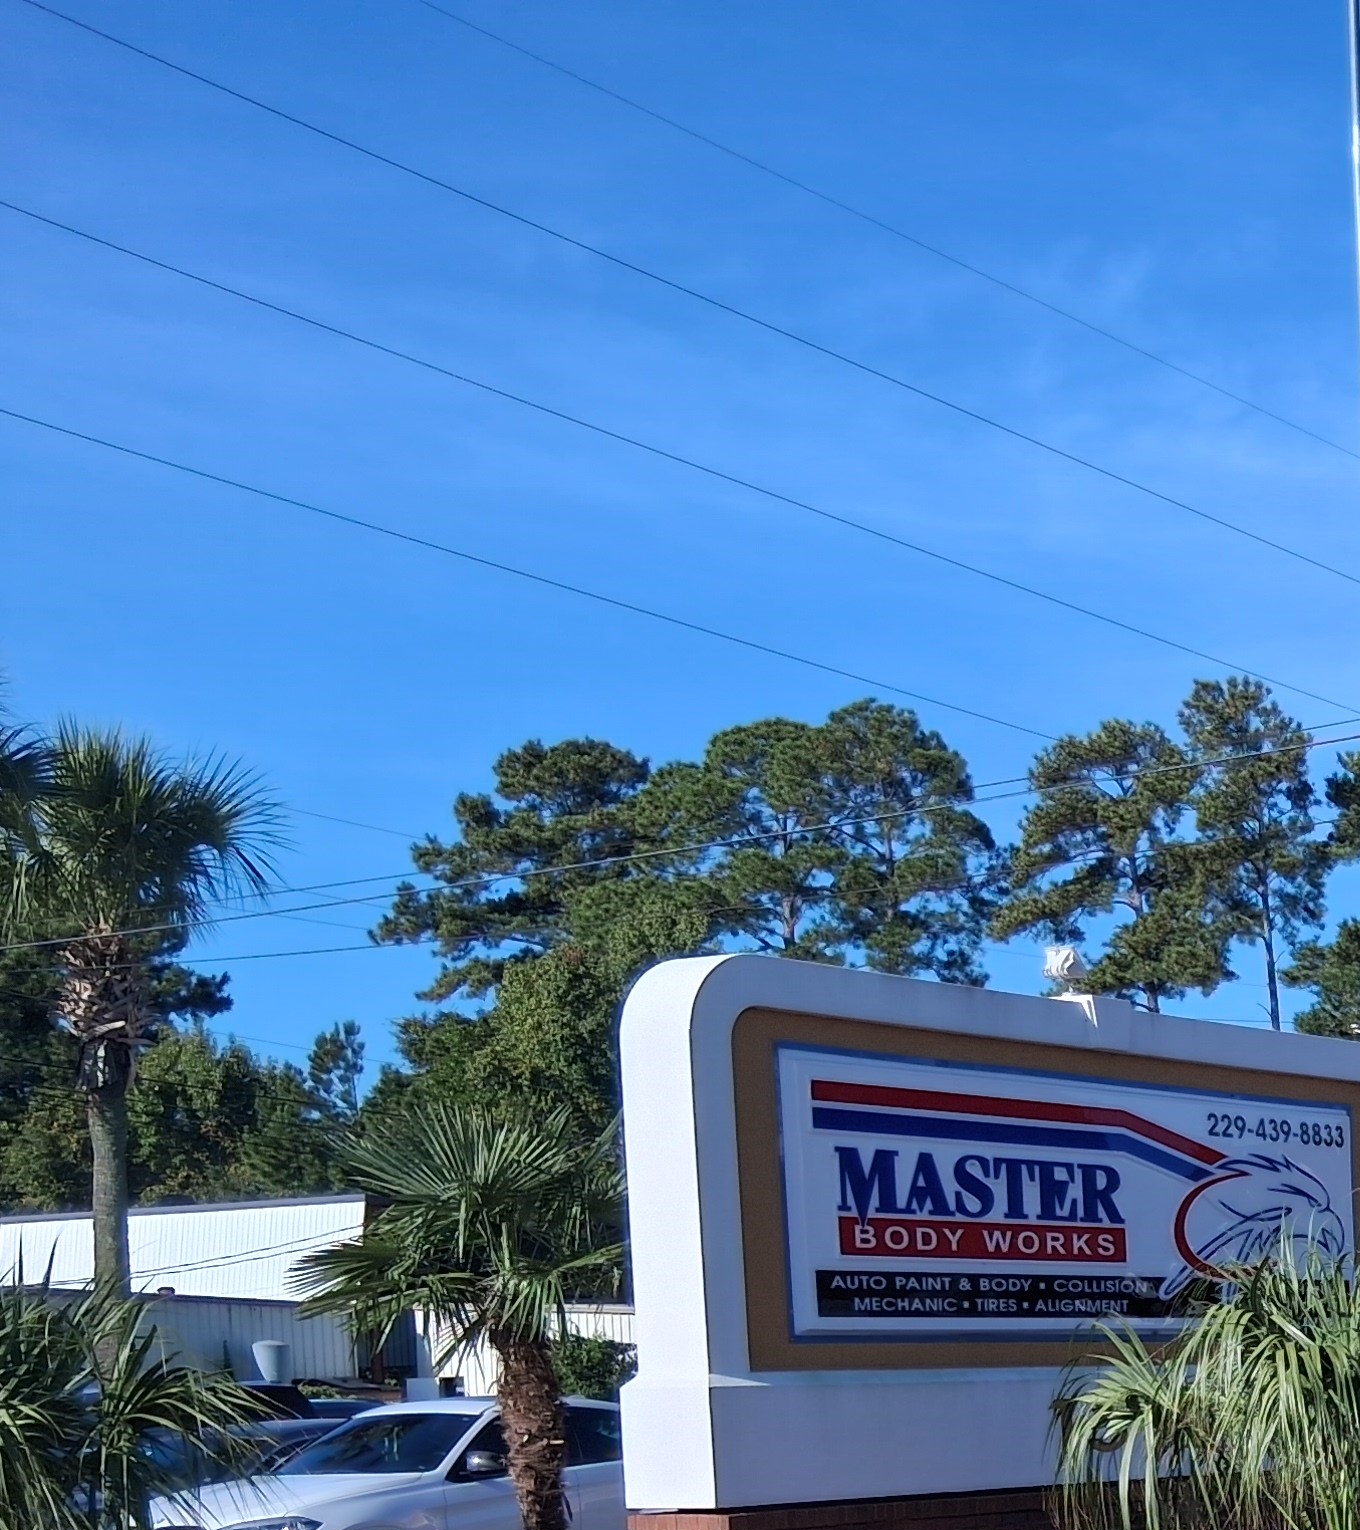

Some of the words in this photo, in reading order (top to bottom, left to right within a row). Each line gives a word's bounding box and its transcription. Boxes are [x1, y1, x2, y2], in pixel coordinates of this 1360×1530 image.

[1207, 1112, 1345, 1148] 229-439-8833
[834, 1146, 1126, 1228] MASTER
[854, 1225, 965, 1252] BODY
[982, 1230, 1116, 1257] WORKS
[830, 1276, 887, 1290] AUTO
[895, 1276, 953, 1291] PAINT
[958, 1277, 973, 1291] &
[979, 1277, 1033, 1292] BODY
[1053, 1279, 1149, 1293] COLLISION
[854, 1298, 958, 1312] MECHANIC
[975, 1298, 1018, 1312] TIRES
[1035, 1298, 1129, 1313] ALIGNMENT
